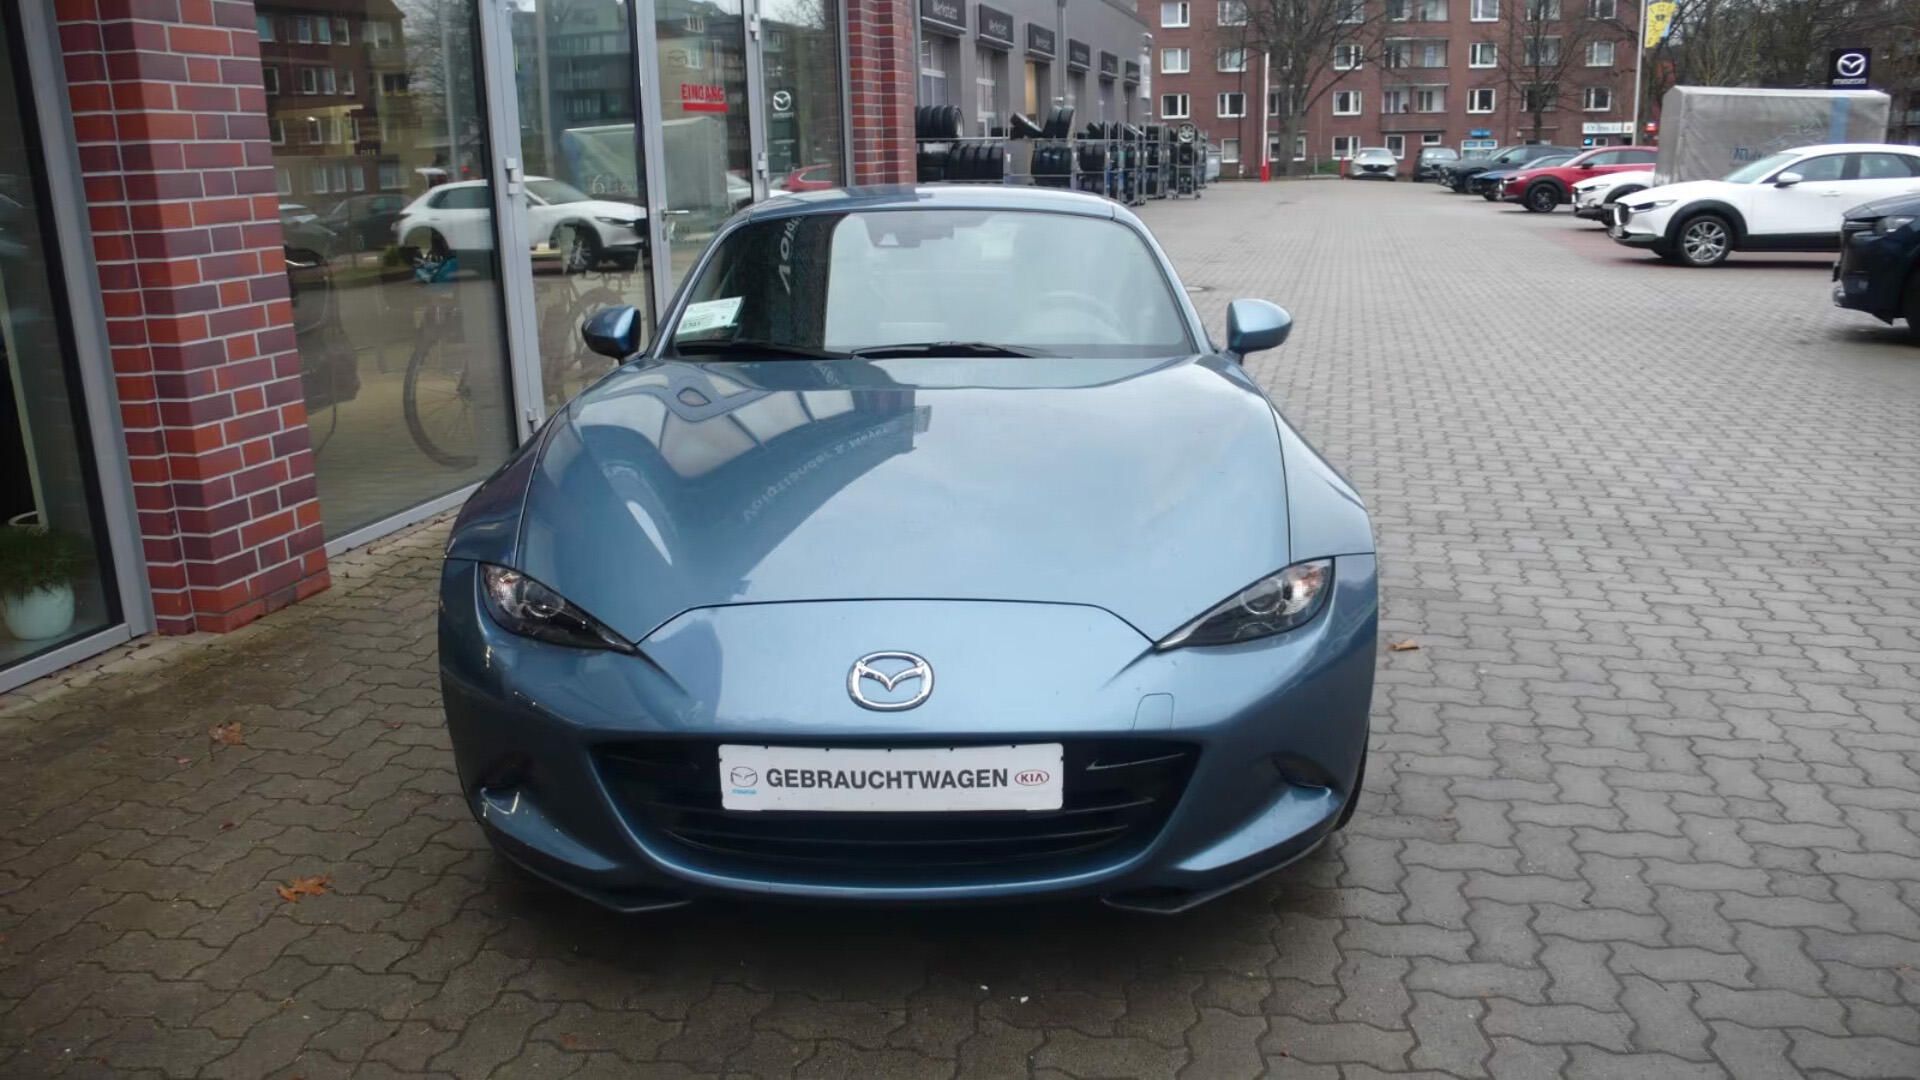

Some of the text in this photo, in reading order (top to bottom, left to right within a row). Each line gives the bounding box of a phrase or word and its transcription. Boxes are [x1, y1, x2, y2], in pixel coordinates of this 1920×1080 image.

[682, 84, 725, 102] EINGANG
[766, 769, 1046, 789] GEBRAUCHTWAGEN KIA
